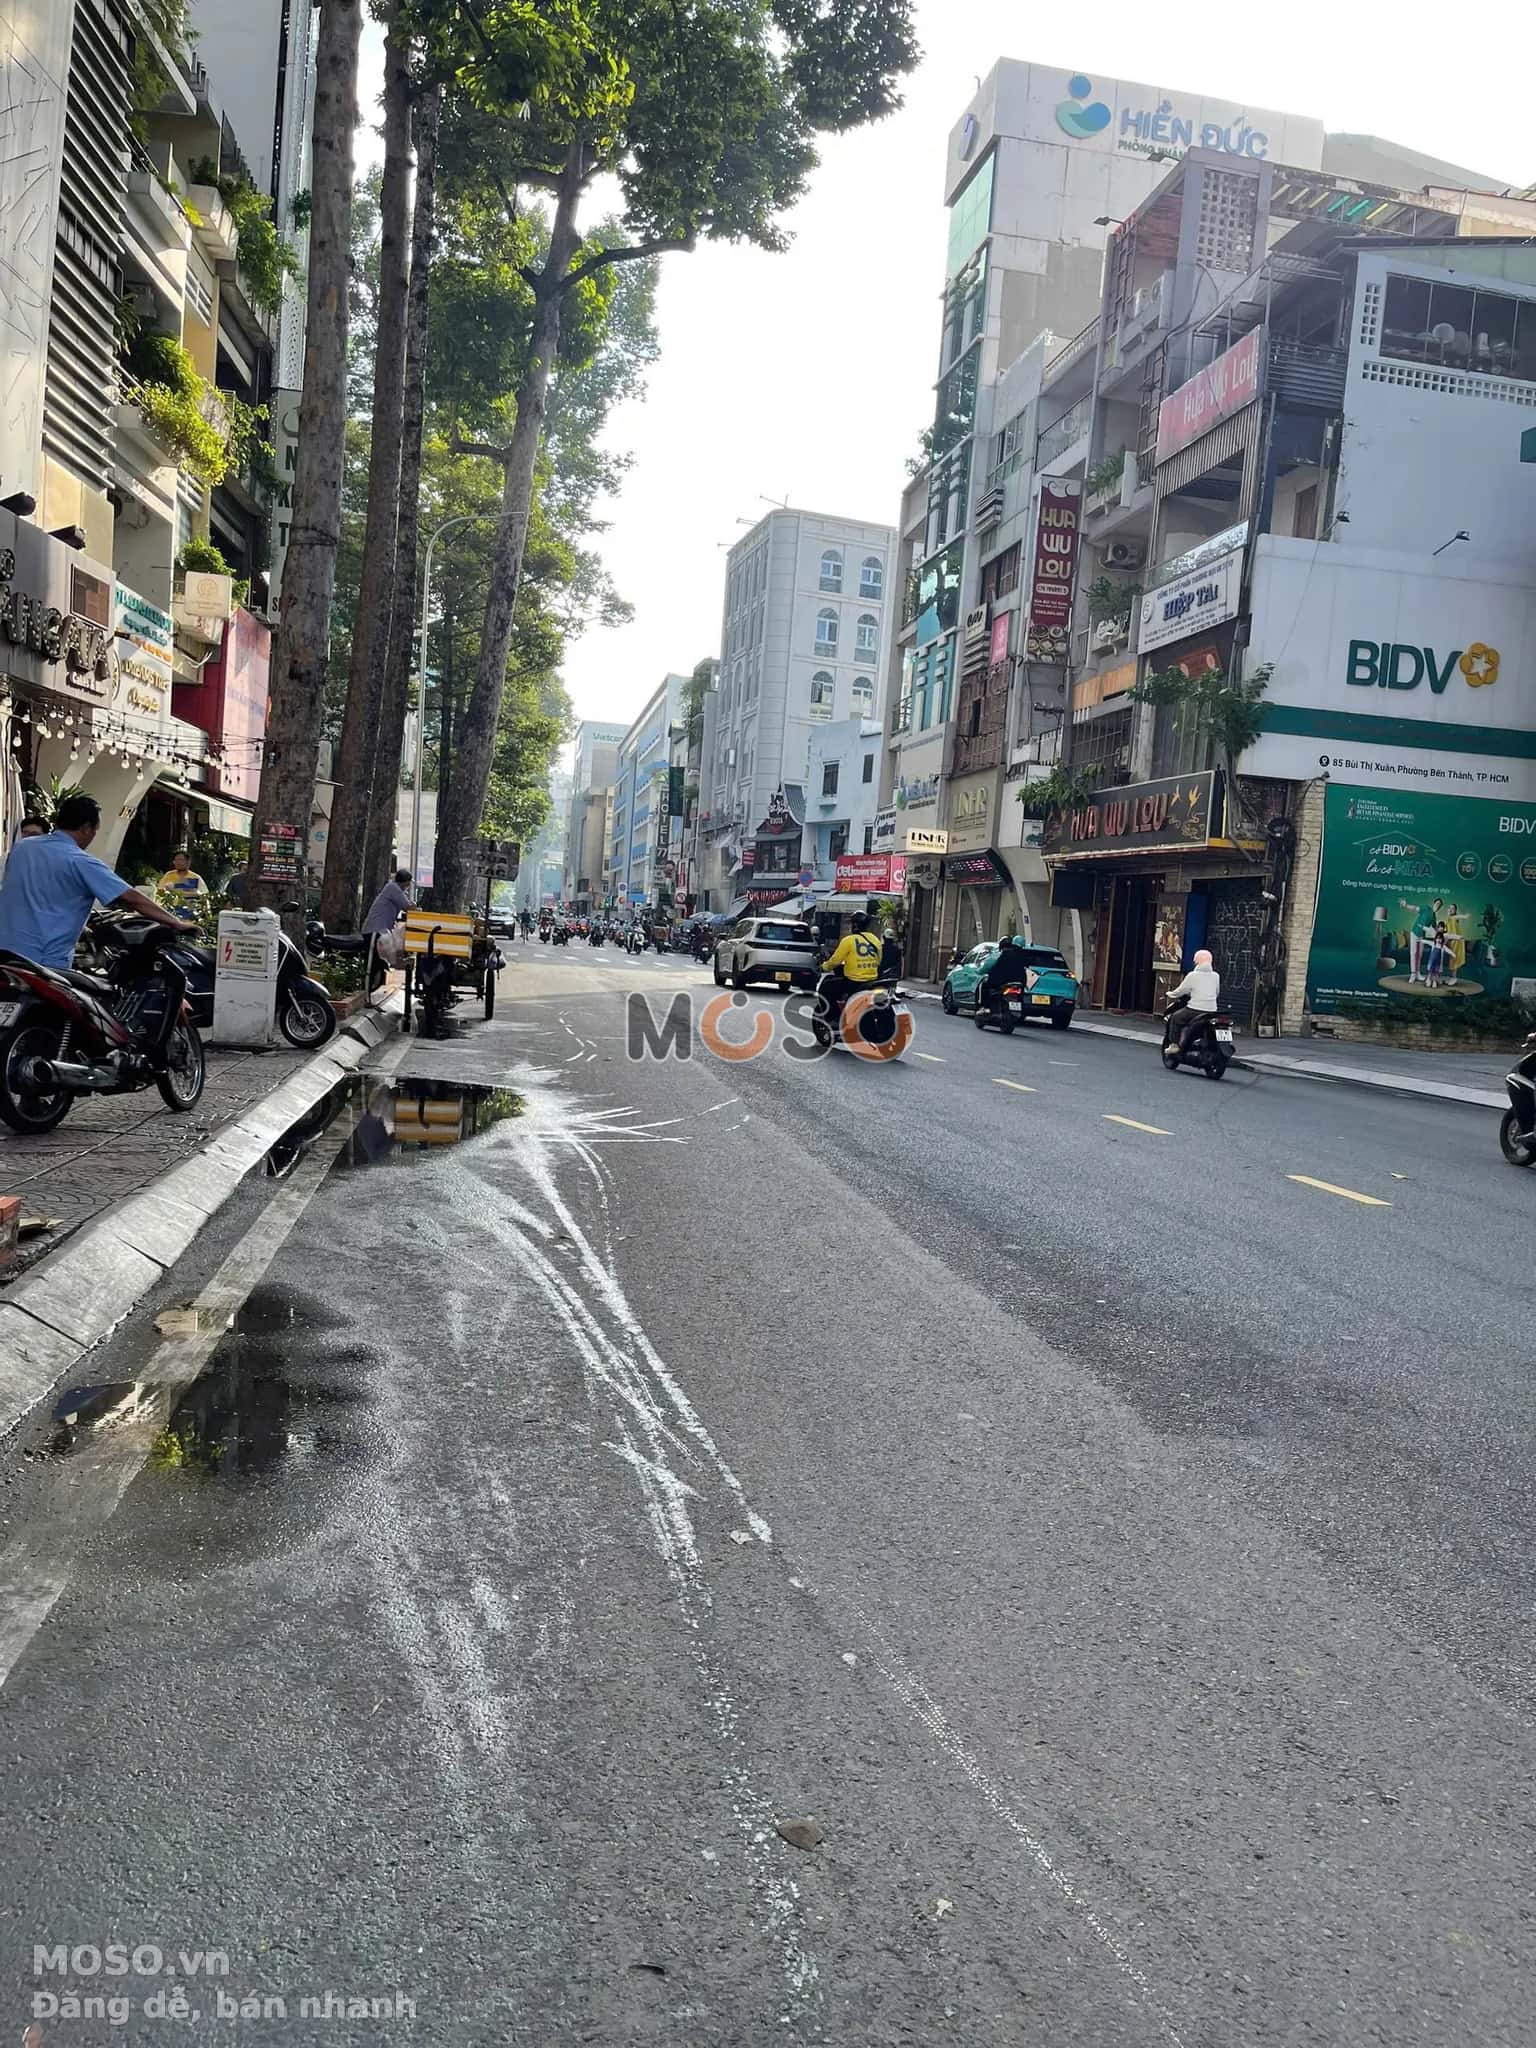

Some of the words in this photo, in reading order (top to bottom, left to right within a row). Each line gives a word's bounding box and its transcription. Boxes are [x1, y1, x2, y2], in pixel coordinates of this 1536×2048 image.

[1041, 506, 1076, 528] HUA
[1042, 532, 1072, 554] WU
[1038, 558, 1071, 580] LOU
[1346, 639, 1463, 695] BIDV
[1332, 758, 1344, 767] 85
[1345, 759, 1359, 769] Bùi
[1361, 760, 1373, 773] Thị
[1397, 764, 1428, 778] Phường
[1430, 766, 1446, 778] Bến
[1489, 774, 1510, 784] HCM
[1070, 805, 1098, 840] HUA
[1104, 800, 1127, 837] WU
[1133, 792, 1169, 833] LOU
[1499, 816, 1536, 834] BIDV
[1382, 843, 1409, 857] BIDV
